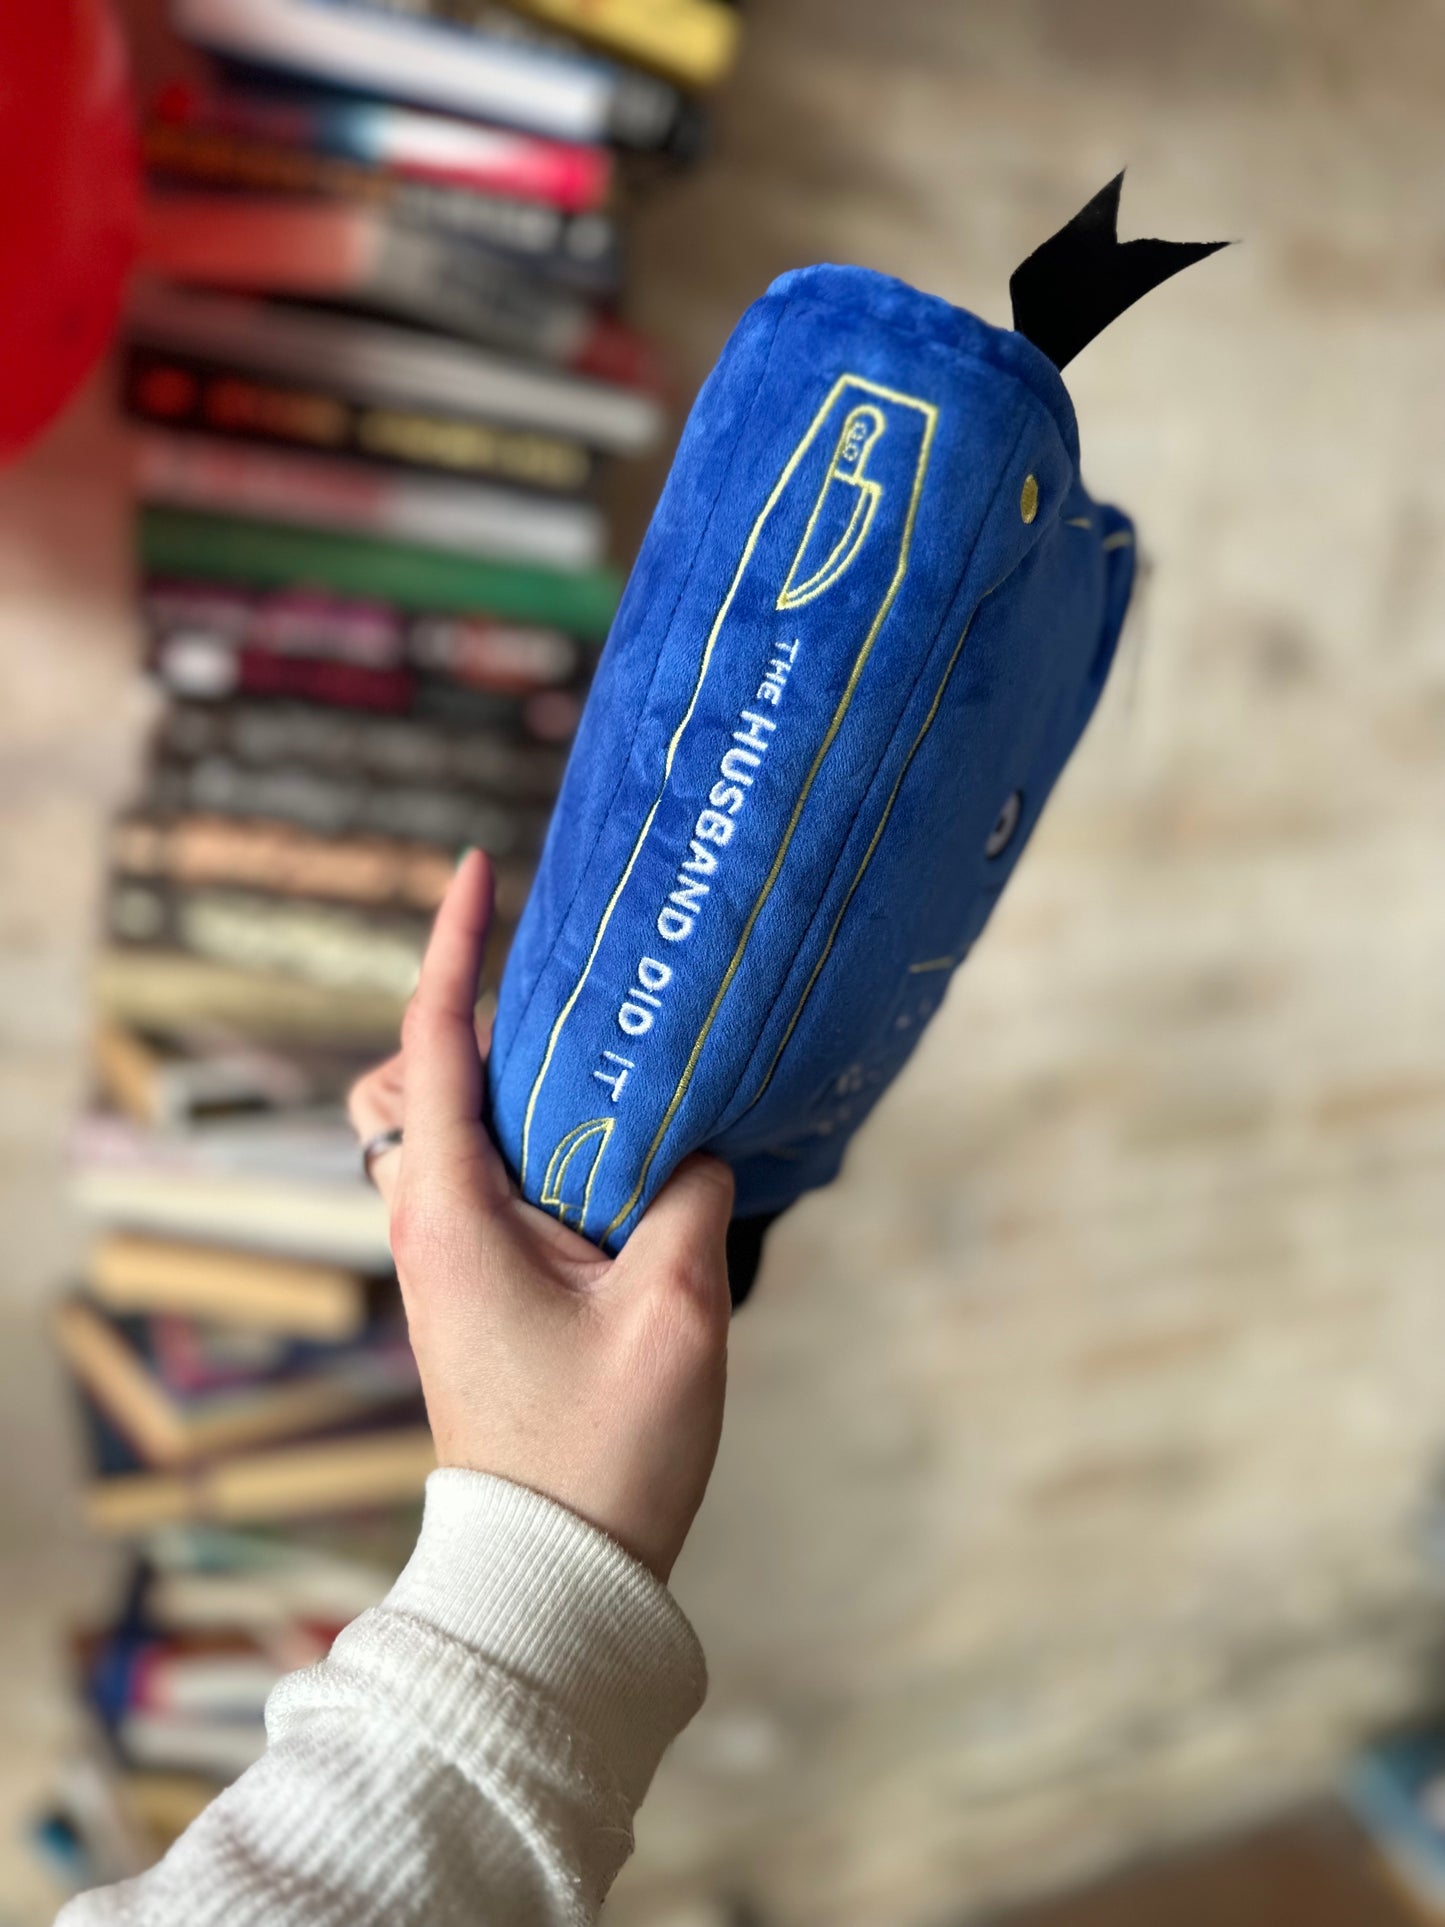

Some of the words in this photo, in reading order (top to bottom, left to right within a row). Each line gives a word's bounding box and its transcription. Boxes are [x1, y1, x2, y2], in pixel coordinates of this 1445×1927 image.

[755, 638, 799, 706] THE
[657, 710, 776, 942] HUSBAND
[618, 956, 673, 1036] DID
[594, 1050, 635, 1102] IT
